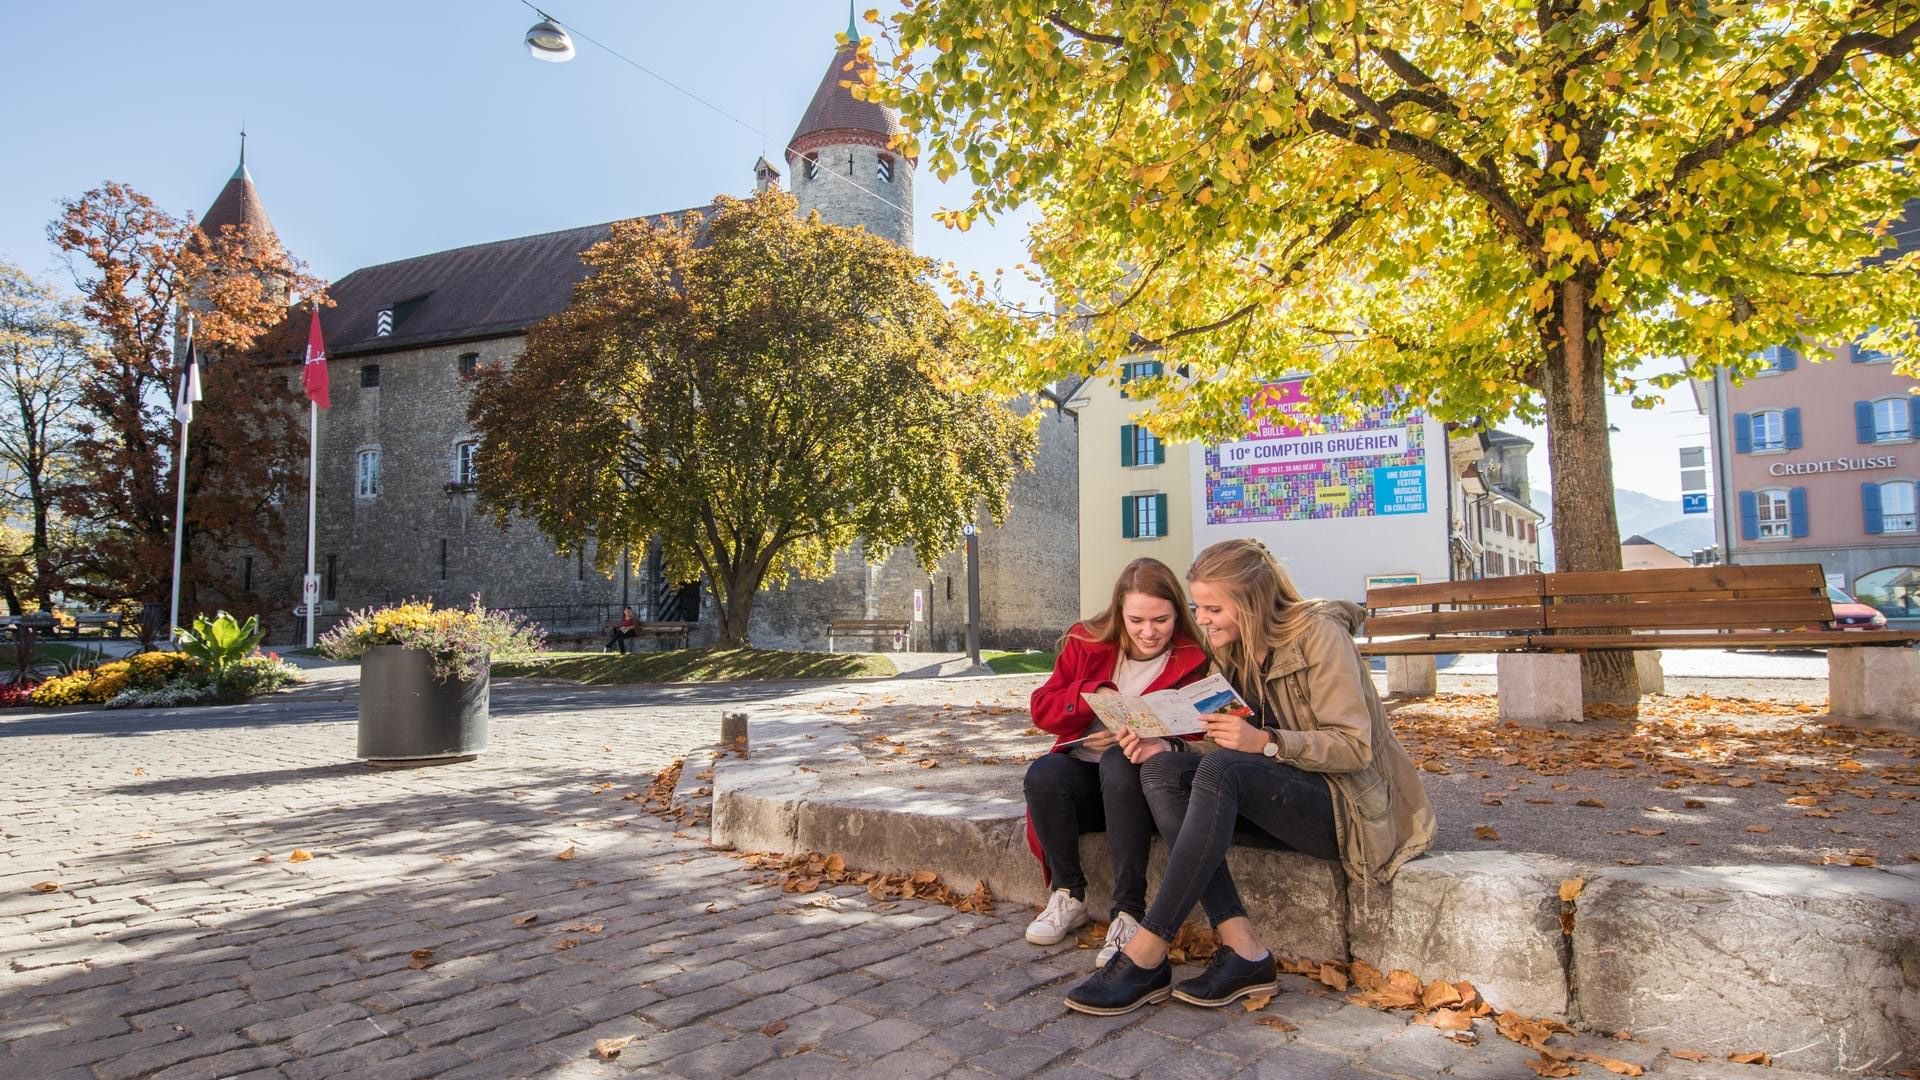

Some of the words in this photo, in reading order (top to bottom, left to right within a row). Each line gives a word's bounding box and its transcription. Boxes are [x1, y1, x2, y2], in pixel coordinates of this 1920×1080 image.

[1263, 425, 1286, 437] BULLE
[1254, 440, 1324, 459] COMPTOIR
[1327, 434, 1399, 454] GRUÉRIEN
[1769, 460, 1835, 476] CREDIT
[1837, 455, 1897, 471] SUISSE
[1393, 486, 1422, 495] MUSICALE
[1403, 494, 1423, 503] HAUTE
